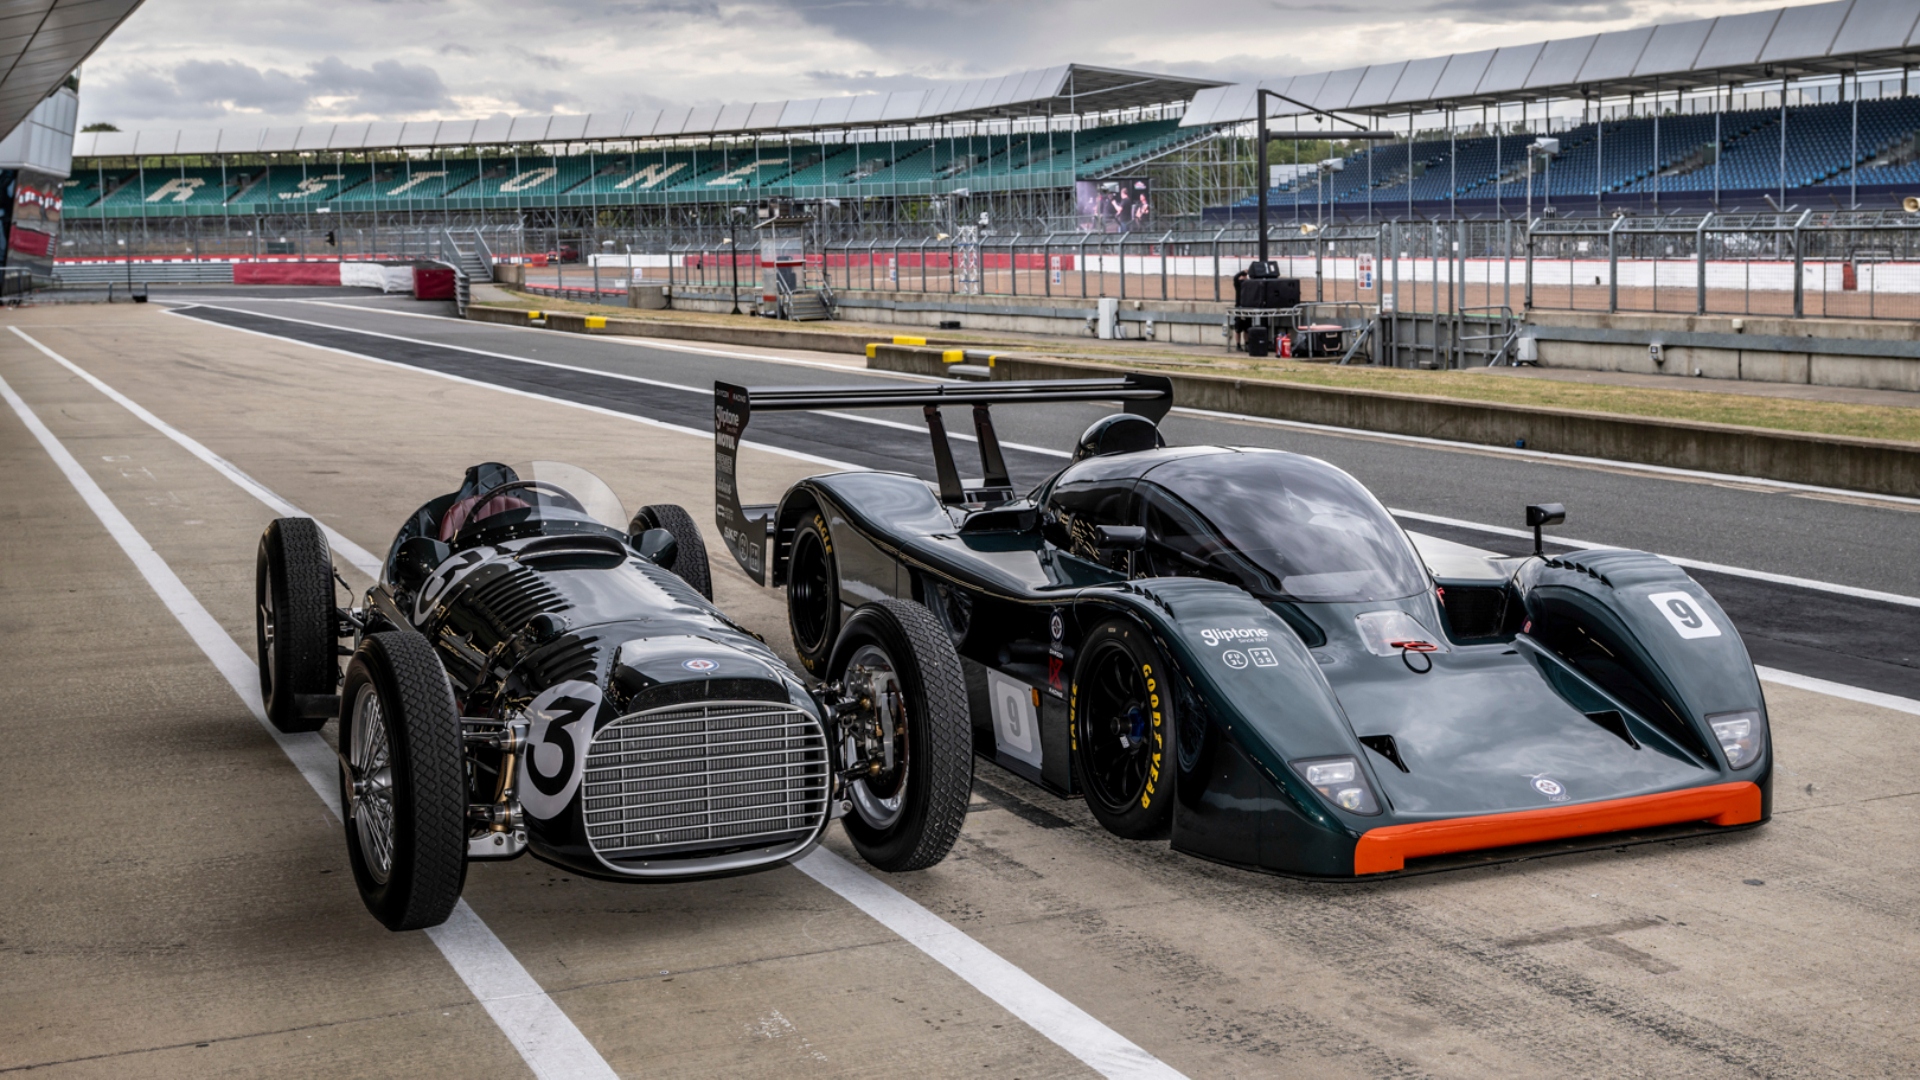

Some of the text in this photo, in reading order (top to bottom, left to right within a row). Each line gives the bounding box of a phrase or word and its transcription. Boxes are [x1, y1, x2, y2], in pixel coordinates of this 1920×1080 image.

[64, 158, 790, 204] RSTONE
[813, 513, 833, 556] EAGLE
[418, 550, 483, 614] 3
[1666, 599, 1703, 629] 9
[1200, 627, 1269, 647] gliptone
[1006, 695, 1022, 737] 9
[526, 695, 596, 797] 3
